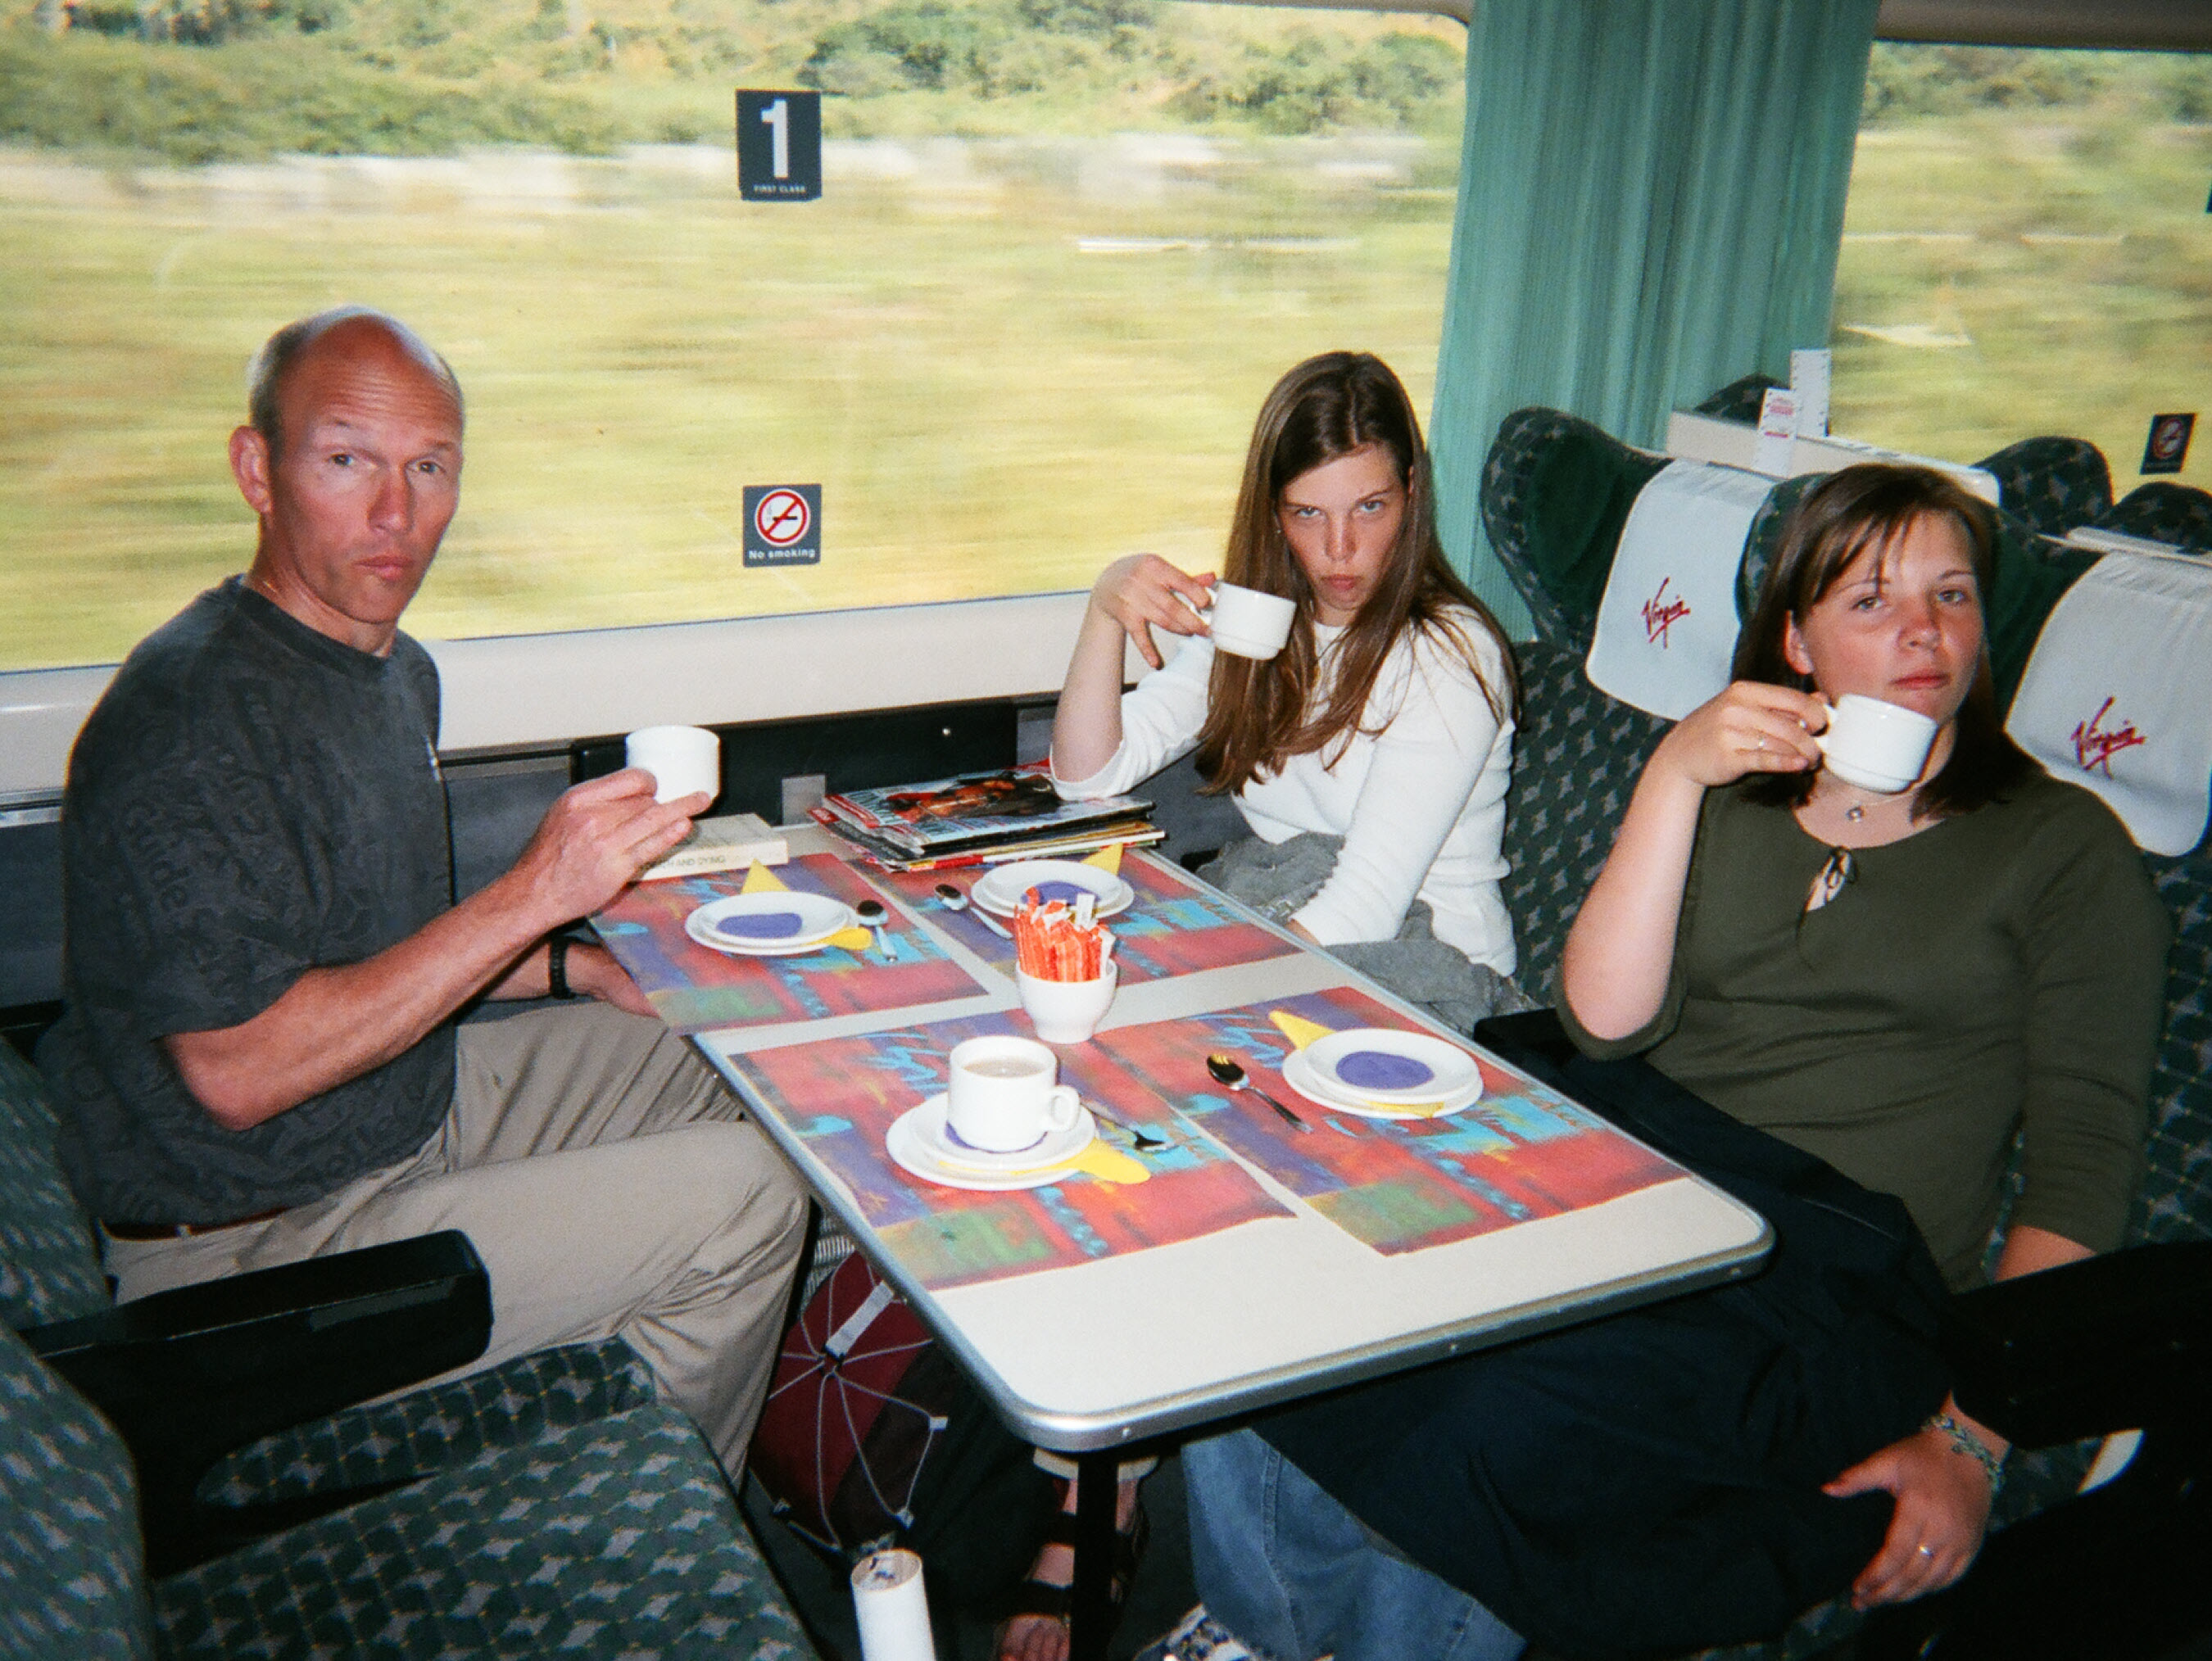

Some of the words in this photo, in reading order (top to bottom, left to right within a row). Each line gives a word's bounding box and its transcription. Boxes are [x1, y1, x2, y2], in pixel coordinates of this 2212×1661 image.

[760, 99, 789, 179] 1
[754, 183, 777, 193] FIRST
[779, 183, 807, 193] CLASS
[749, 550, 765, 560] No
[768, 548, 816, 560] smoking
[1640, 577, 1691, 649] Virgin
[2069, 696, 2146, 780] Virgin
[676, 858, 696, 867] AND
